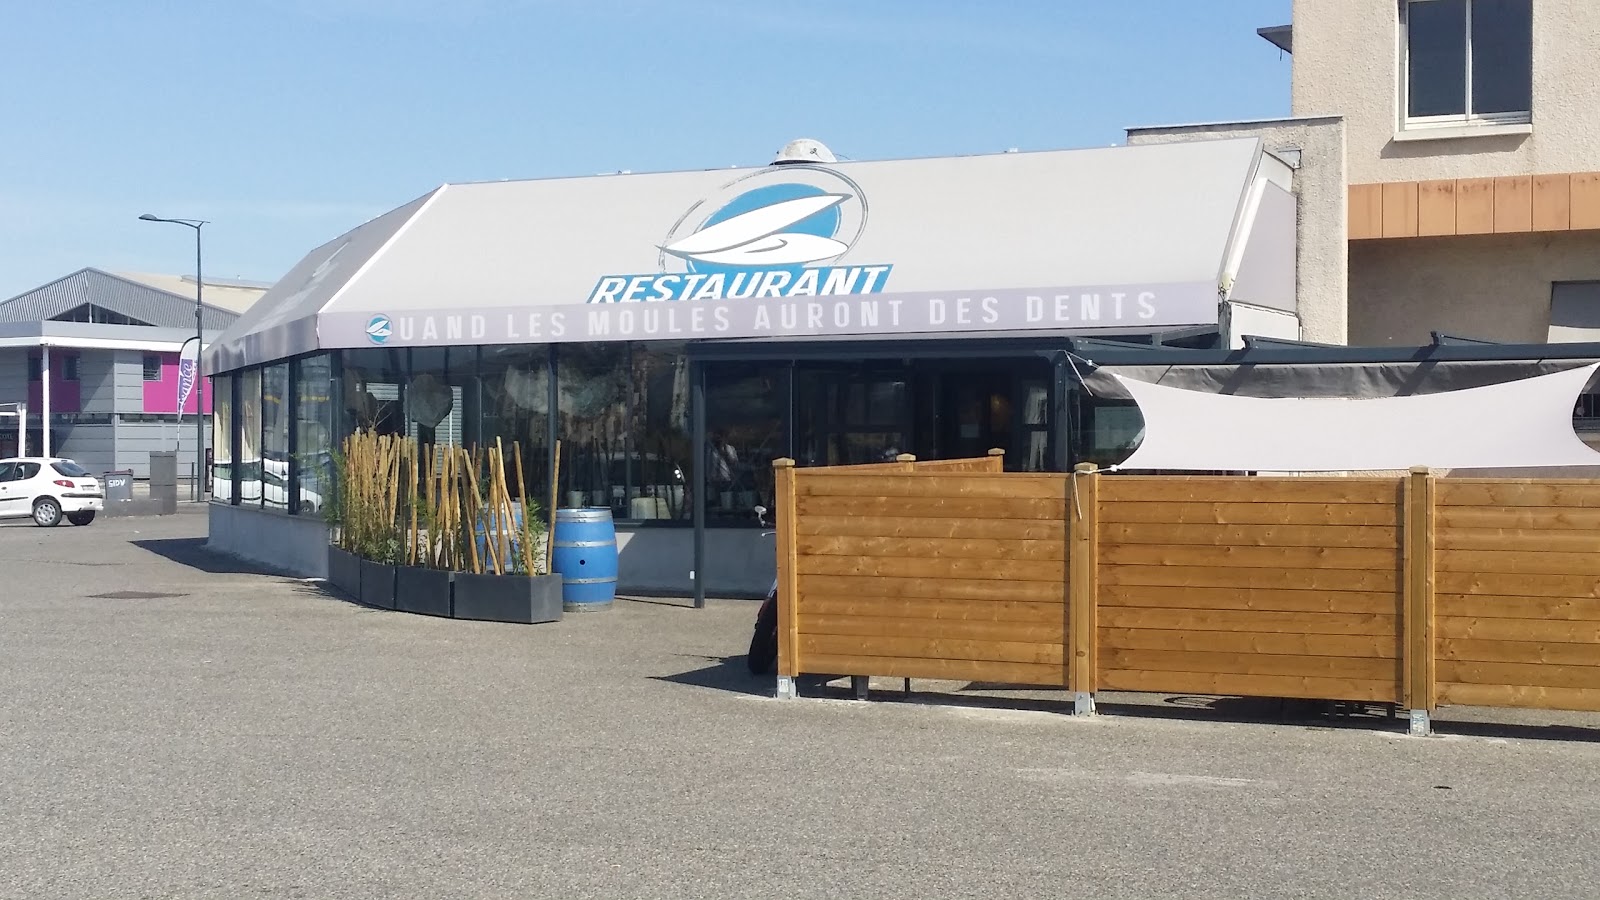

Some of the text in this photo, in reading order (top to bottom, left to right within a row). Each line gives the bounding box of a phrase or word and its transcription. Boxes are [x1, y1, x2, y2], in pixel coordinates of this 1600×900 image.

[590, 266, 888, 303] RESTAURANT
[507, 312, 566, 338] LES
[588, 305, 730, 336] MOULES
[753, 300, 902, 330] AURONT
[930, 296, 999, 325] DES
[1026, 291, 1157, 322] DENTS
